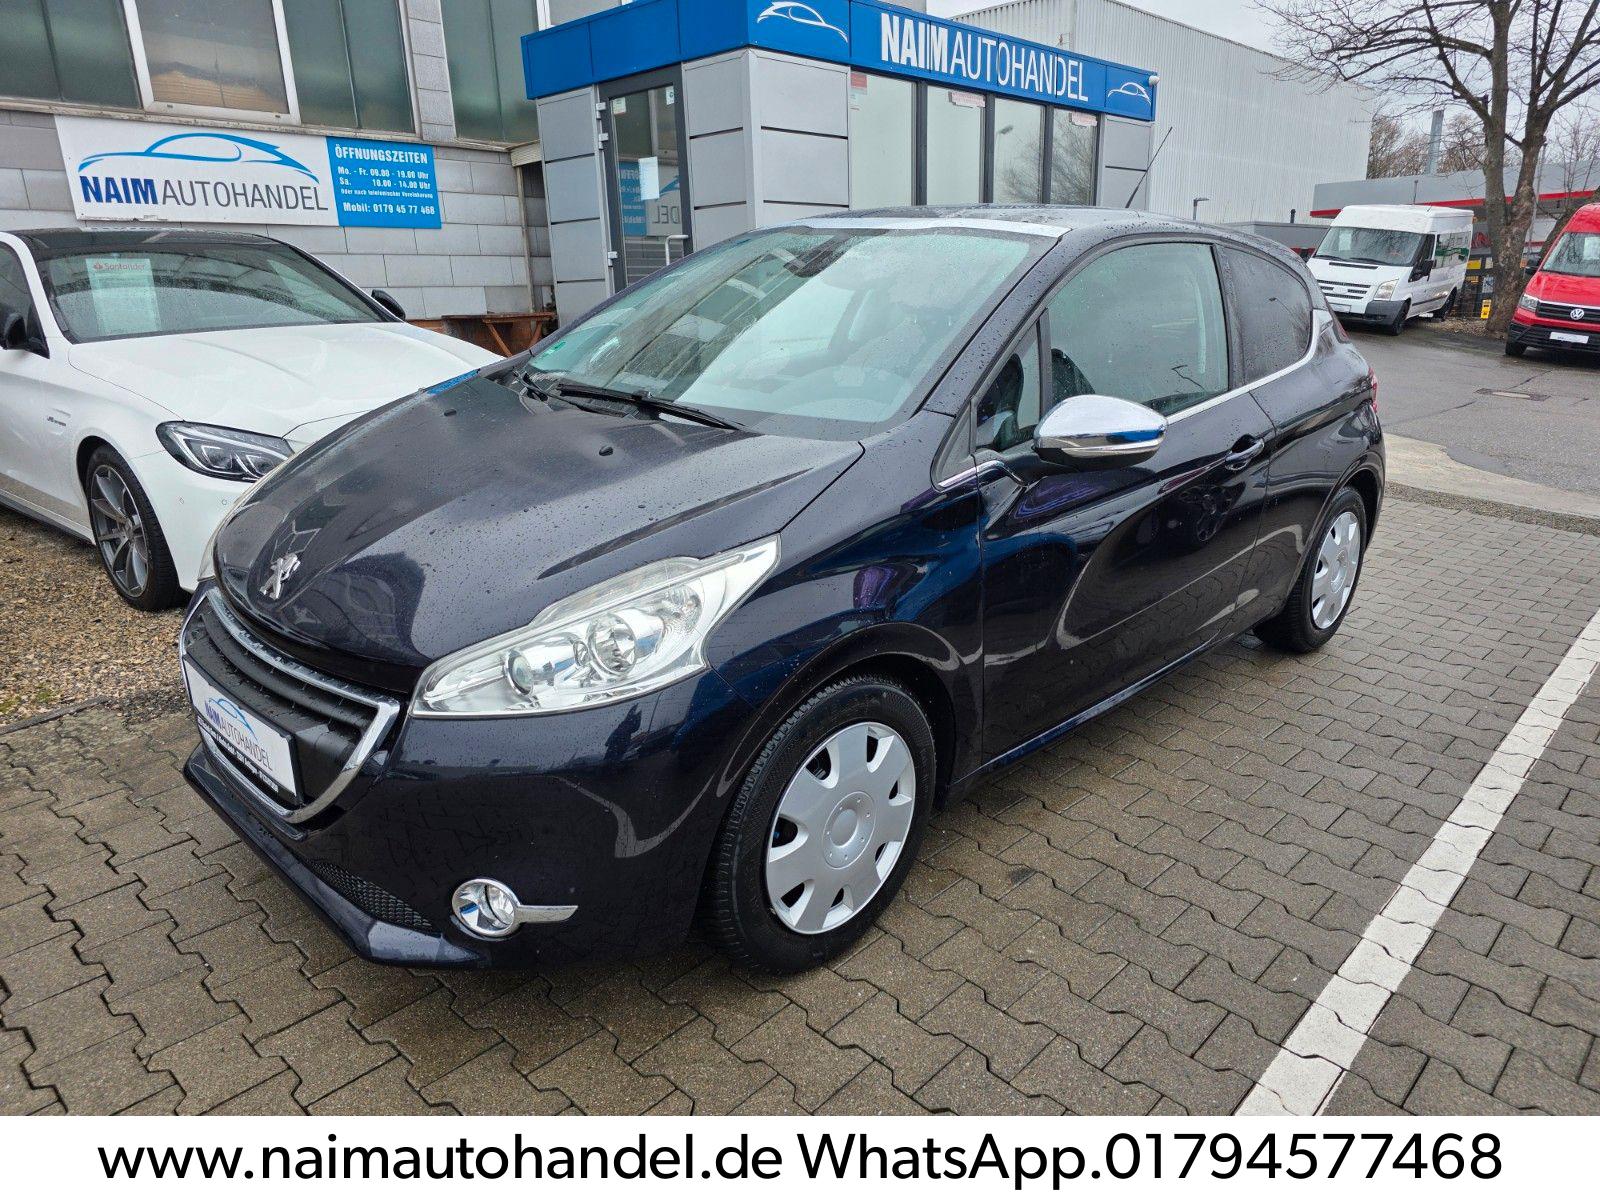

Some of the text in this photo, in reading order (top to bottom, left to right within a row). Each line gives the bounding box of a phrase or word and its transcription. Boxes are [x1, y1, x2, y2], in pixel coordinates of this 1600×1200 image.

[881, 12, 1089, 102] NAIM AUTOHANDEL
[335, 144, 428, 164] ÖFFNUNGSZEITEN
[337, 166, 352, 175] Mo.
[359, 167, 368, 176] Fr.
[417, 170, 429, 180] Uhr
[339, 176, 352, 186] Sa.
[419, 181, 431, 190] Uhr
[79, 175, 329, 212] NAIM AUTOHANDEL
[342, 202, 435, 215] Mobil: 0179 45 77 468
[104, 262, 145, 271] Santander
[219, 716, 273, 772] AUTOHANDEL
